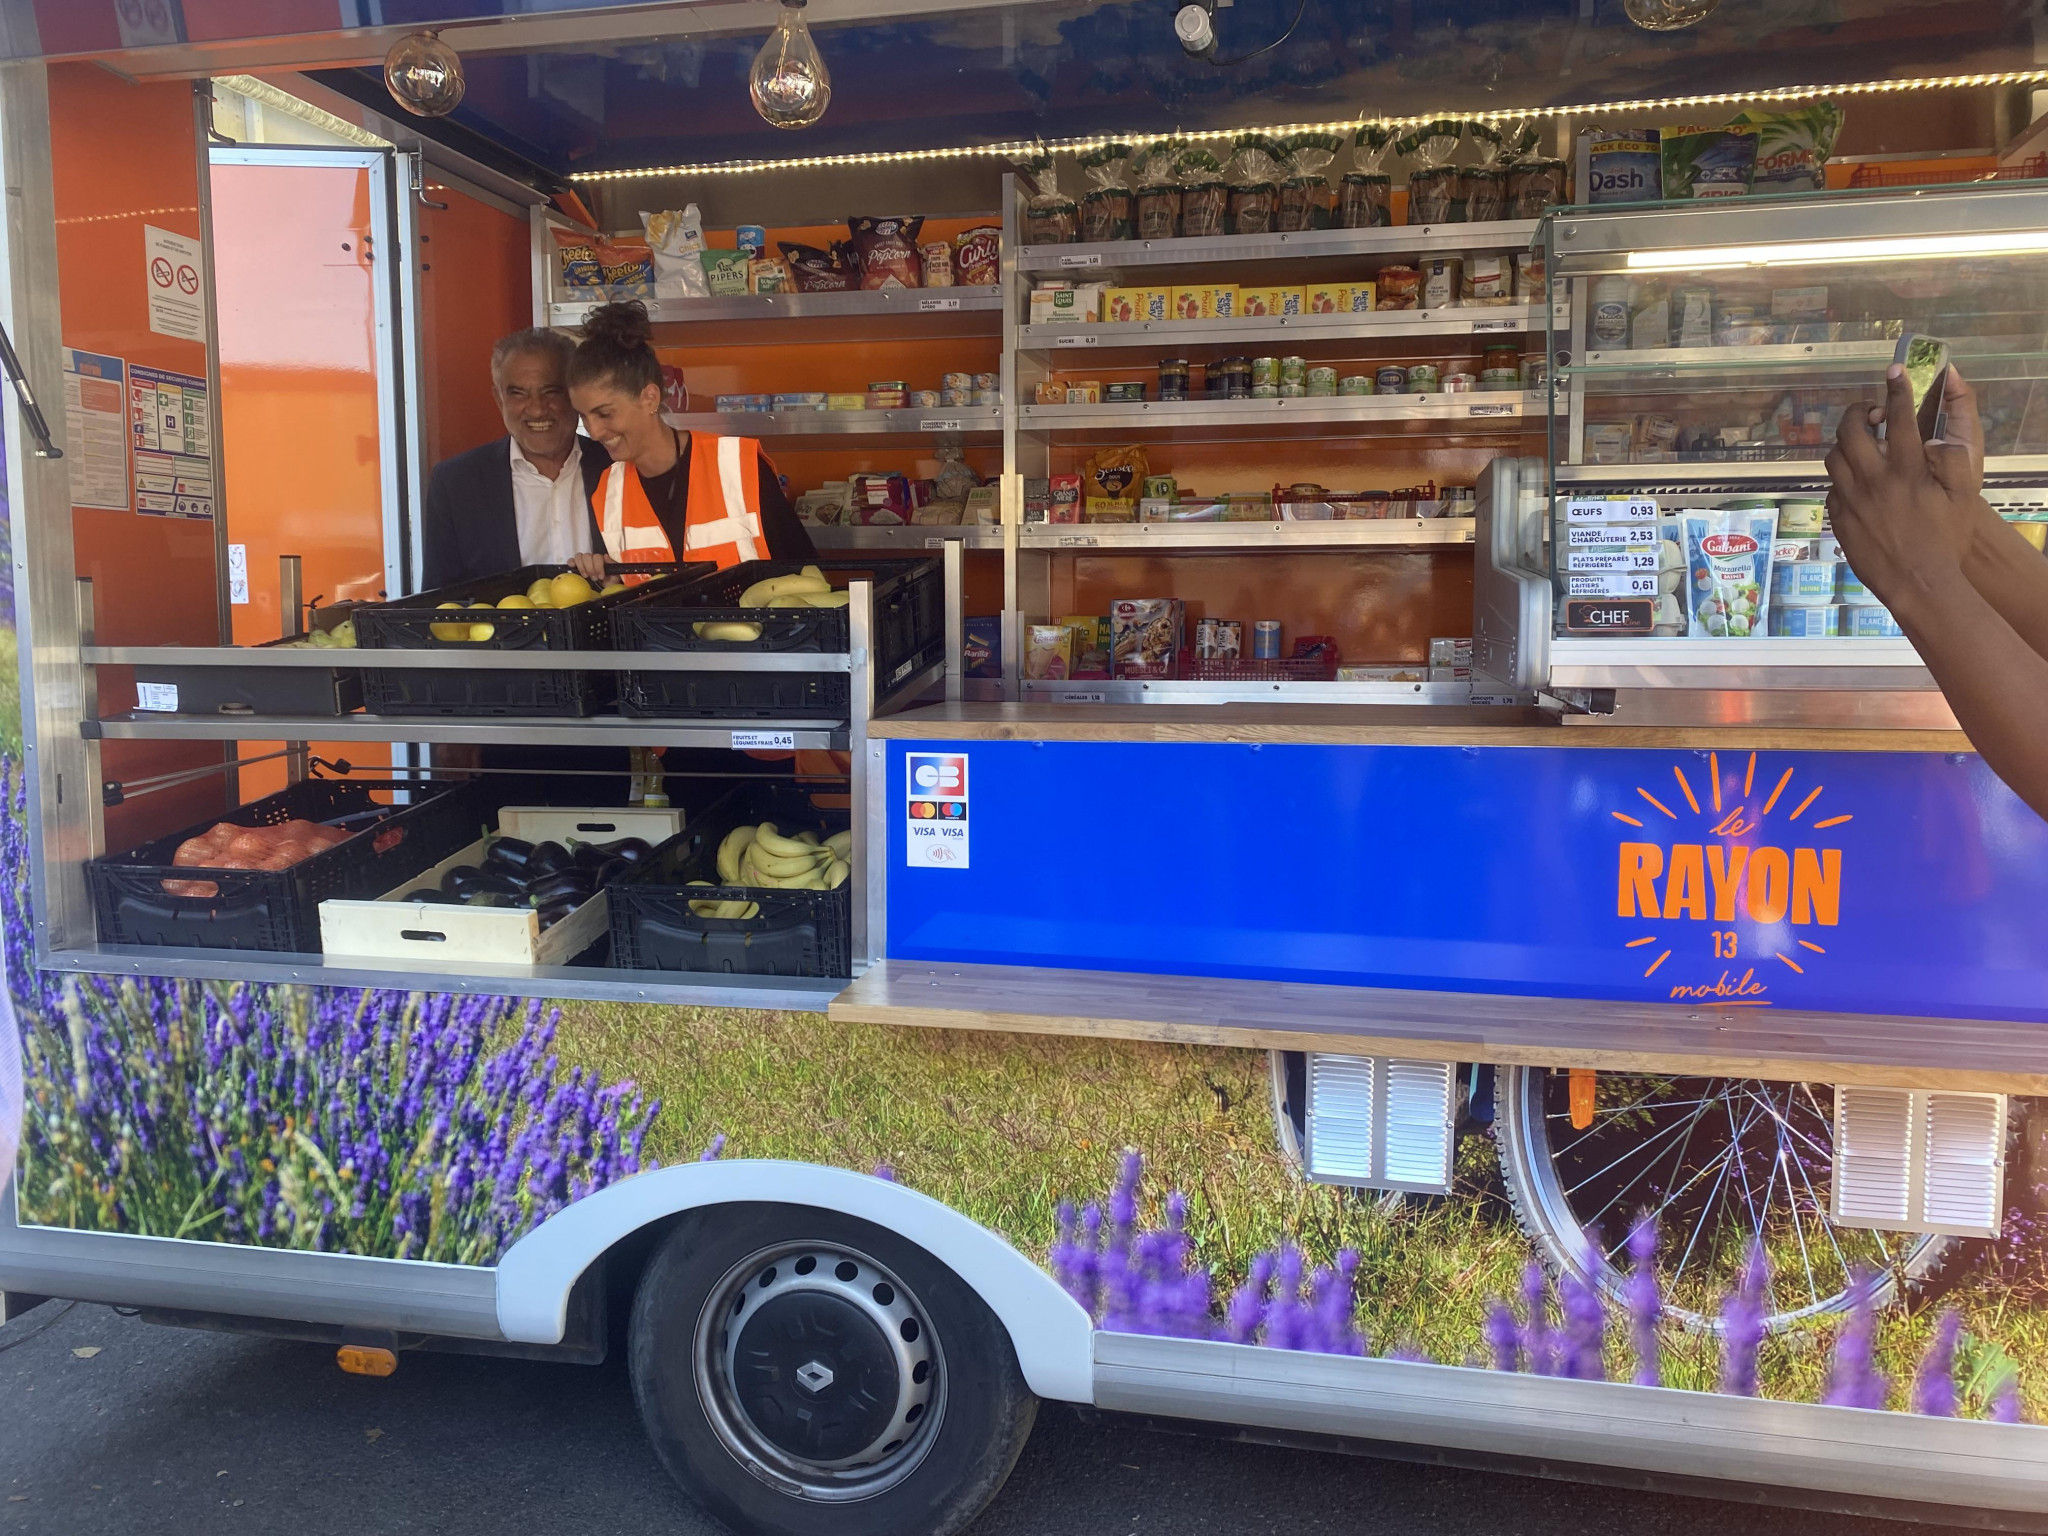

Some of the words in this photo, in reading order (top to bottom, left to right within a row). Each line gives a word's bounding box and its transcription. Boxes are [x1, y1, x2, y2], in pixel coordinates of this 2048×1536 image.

[1590, 143, 1614, 153] ACK
[1589, 167, 1644, 192] Dash
[959, 240, 999, 268] Curly
[710, 271, 744, 282] PIPERS
[1055, 297, 1073, 305] LOUIS
[1095, 501, 1107, 509] 60
[1572, 508, 1602, 516] ŒUFS
[1630, 506, 1653, 516] 0,93
[1810, 510, 1818, 521] 3
[1630, 531, 1653, 542] 2,53
[1706, 540, 1752, 554] Galbani
[1774, 546, 1798, 558] ockey
[1633, 556, 1654, 567] 1,29
[1713, 564, 1752, 572] Mozzarella
[1632, 580, 1653, 591] 0,61
[1589, 610, 1630, 624] CHEF
[1124, 666, 1151, 674] MUESLI
[774, 736, 792, 745] 0,45
[915, 764, 960, 787] CB
[1709, 806, 1755, 837] le
[912, 826, 936, 836] VISA
[940, 827, 964, 837] VISA
[1617, 842, 1842, 926] RAYON
[1711, 931, 1738, 958] 13
[1670, 968, 1767, 998] mobile
